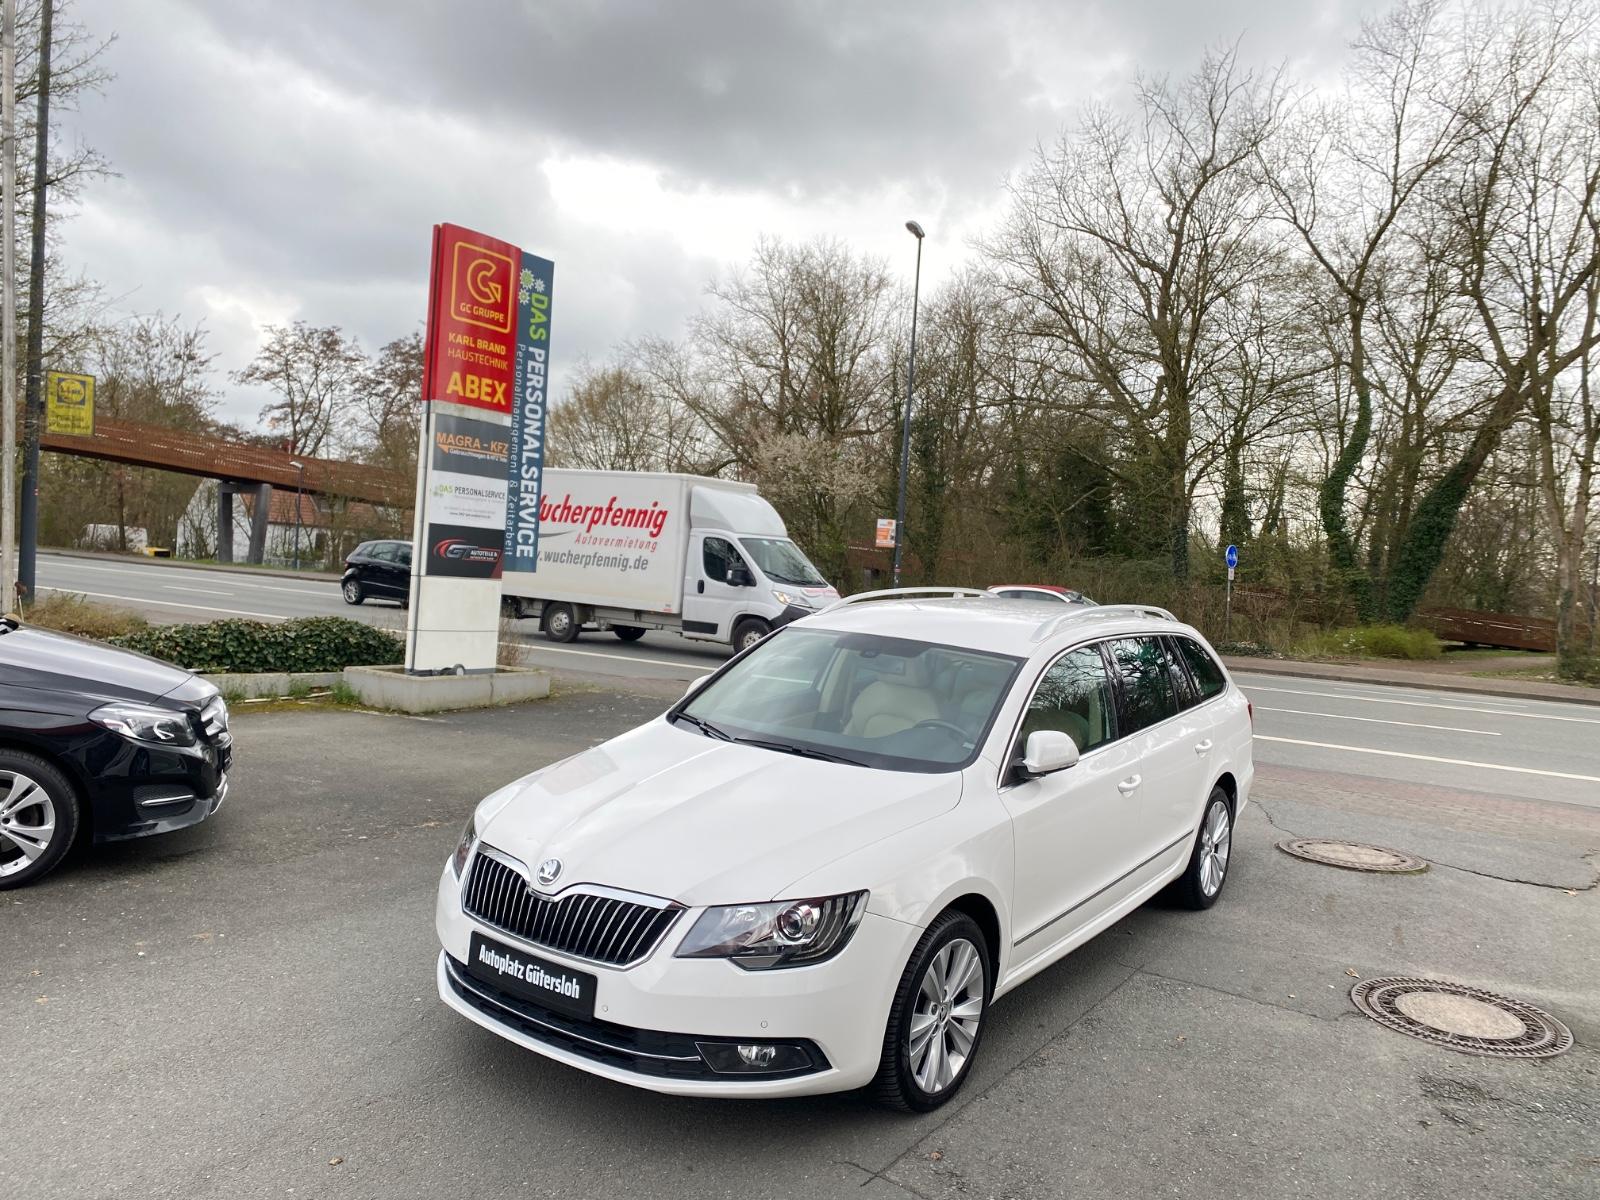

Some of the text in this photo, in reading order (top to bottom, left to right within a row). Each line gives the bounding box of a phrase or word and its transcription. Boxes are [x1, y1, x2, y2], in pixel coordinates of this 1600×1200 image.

[460, 302, 505, 323] GC GRUPPE
[448, 332, 507, 356] KARL BRAND
[447, 347, 509, 371] HAUSTECHNIK
[446, 371, 507, 406] ABEX
[509, 343, 526, 473] Personalmanagement
[516, 292, 548, 558] DAS PERSONALSERVICE
[436, 431, 481, 449] MAGRA
[490, 440, 509, 454] KFZ
[439, 485, 453, 494] DAS
[454, 486, 506, 500] PERSONALSERVICE
[504, 495, 518, 555] Zeitarbeit
[539, 494, 668, 538] ucherpfennig
[575, 533, 658, 553] Autovermietung
[537, 550, 649, 572] .wucherpfennig.de
[479, 944, 580, 999] Autoplatz Gütersloh
